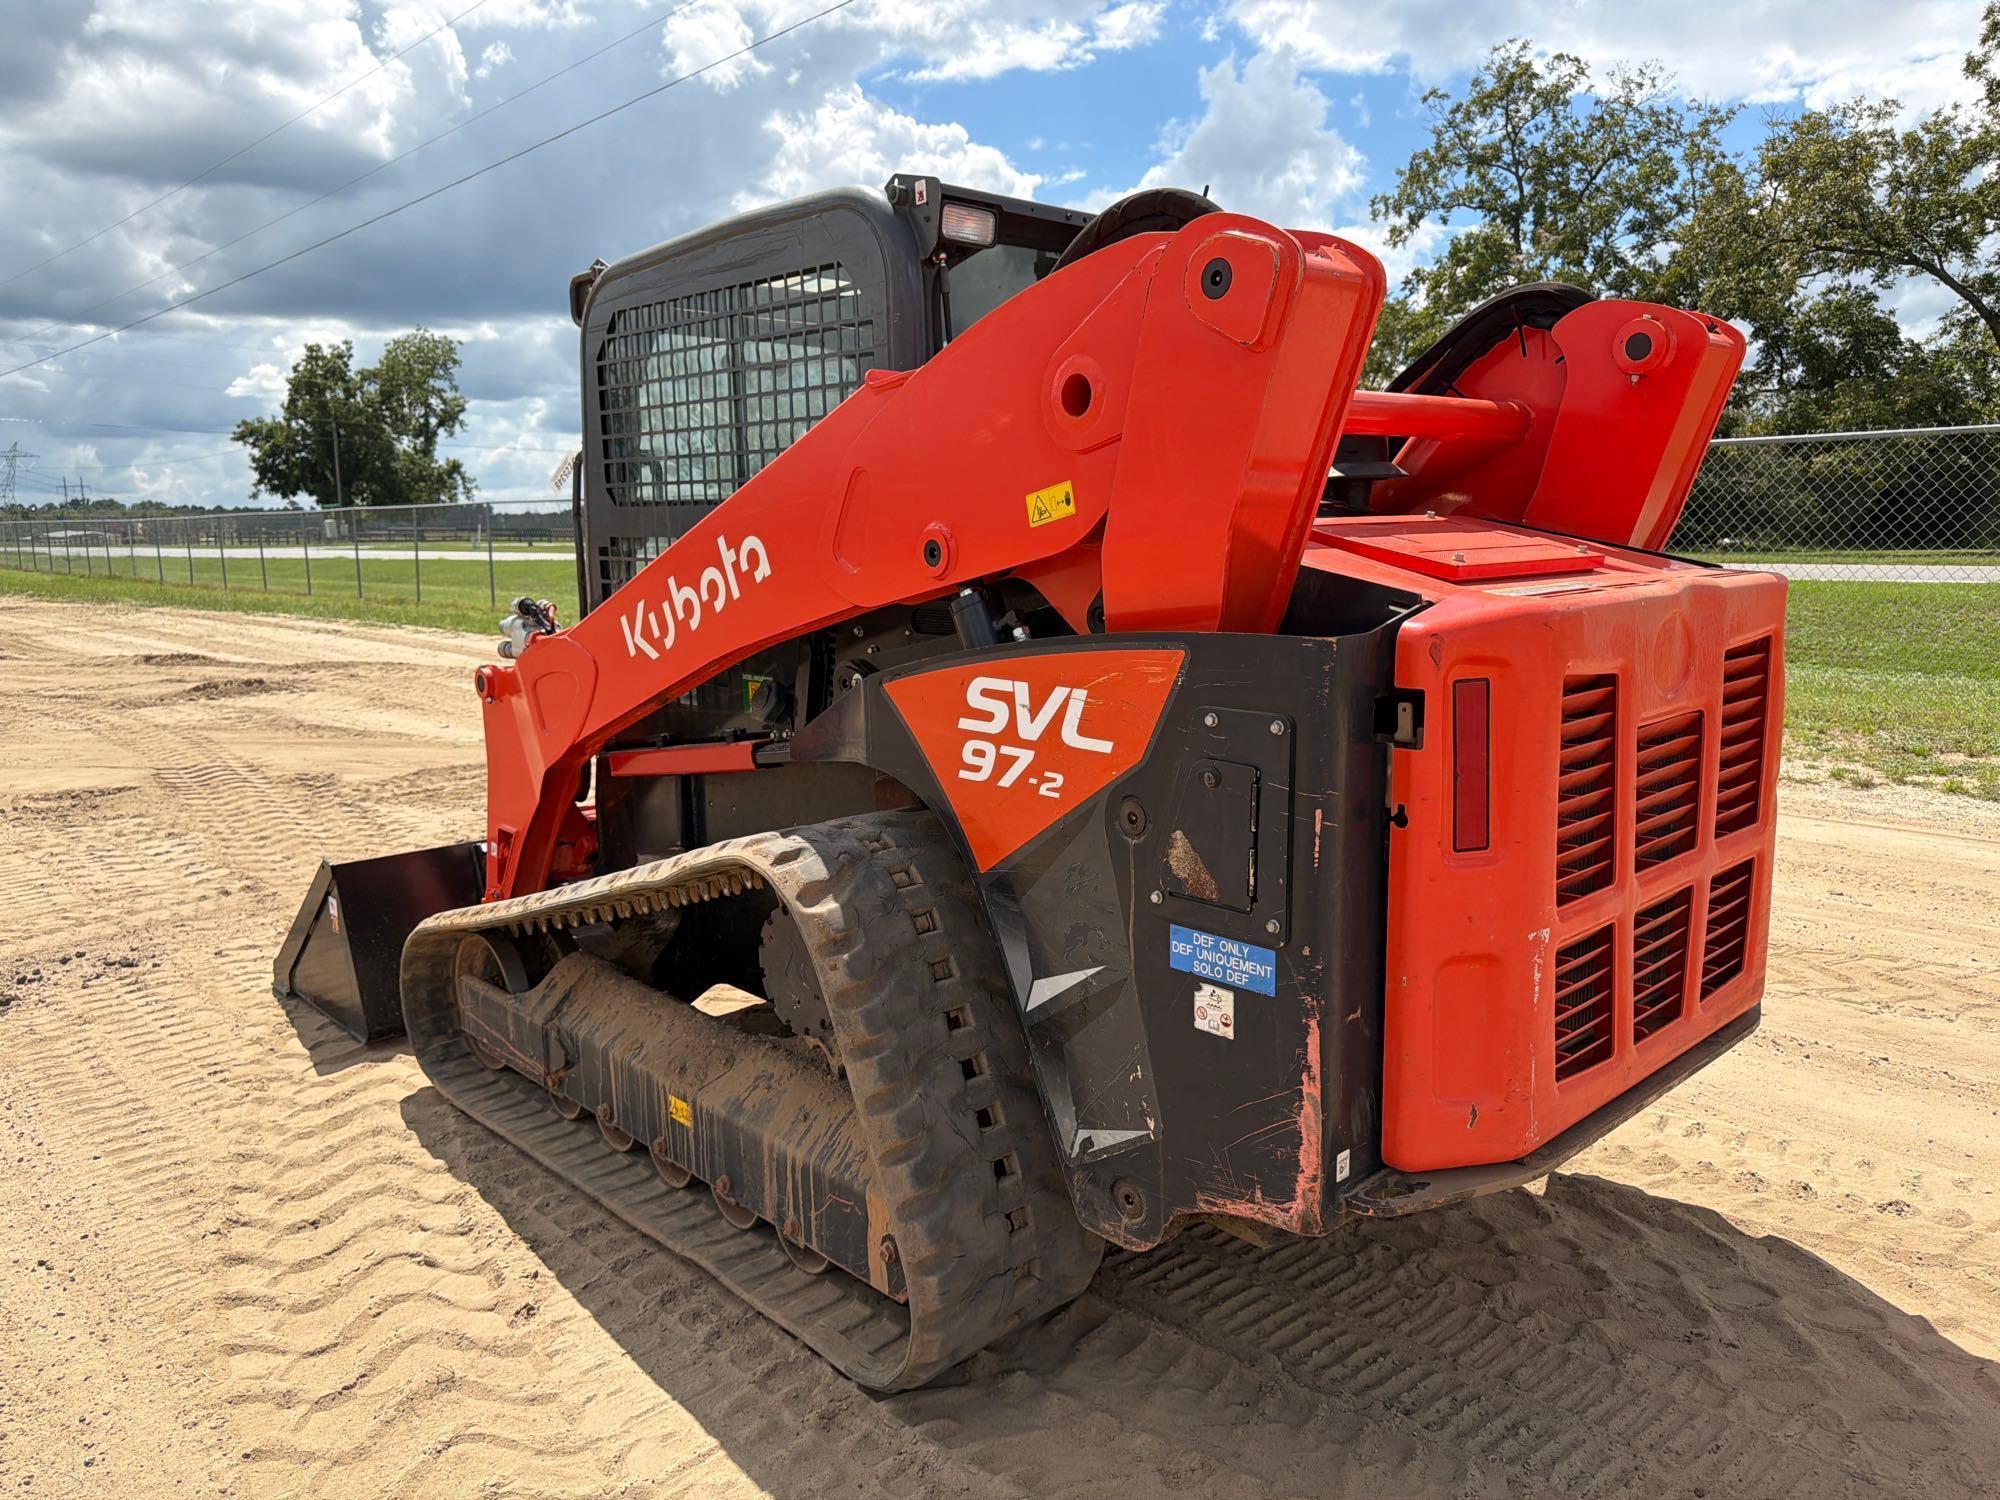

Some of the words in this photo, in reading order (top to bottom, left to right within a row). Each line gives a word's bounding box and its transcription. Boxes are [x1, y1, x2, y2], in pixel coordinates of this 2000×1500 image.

[620, 534, 772, 660] Kubota
[957, 676, 1114, 754] SVL
[957, 739, 1064, 799] 97-2
[1172, 941, 1193, 956] DEF
[1196, 948, 1273, 979] UNIQUEMENT
[1193, 932, 1215, 949] DEF
[1219, 940, 1250, 958] ONLY
[1193, 960, 1223, 978] SOLO
[1226, 969, 1250, 986] DEF
